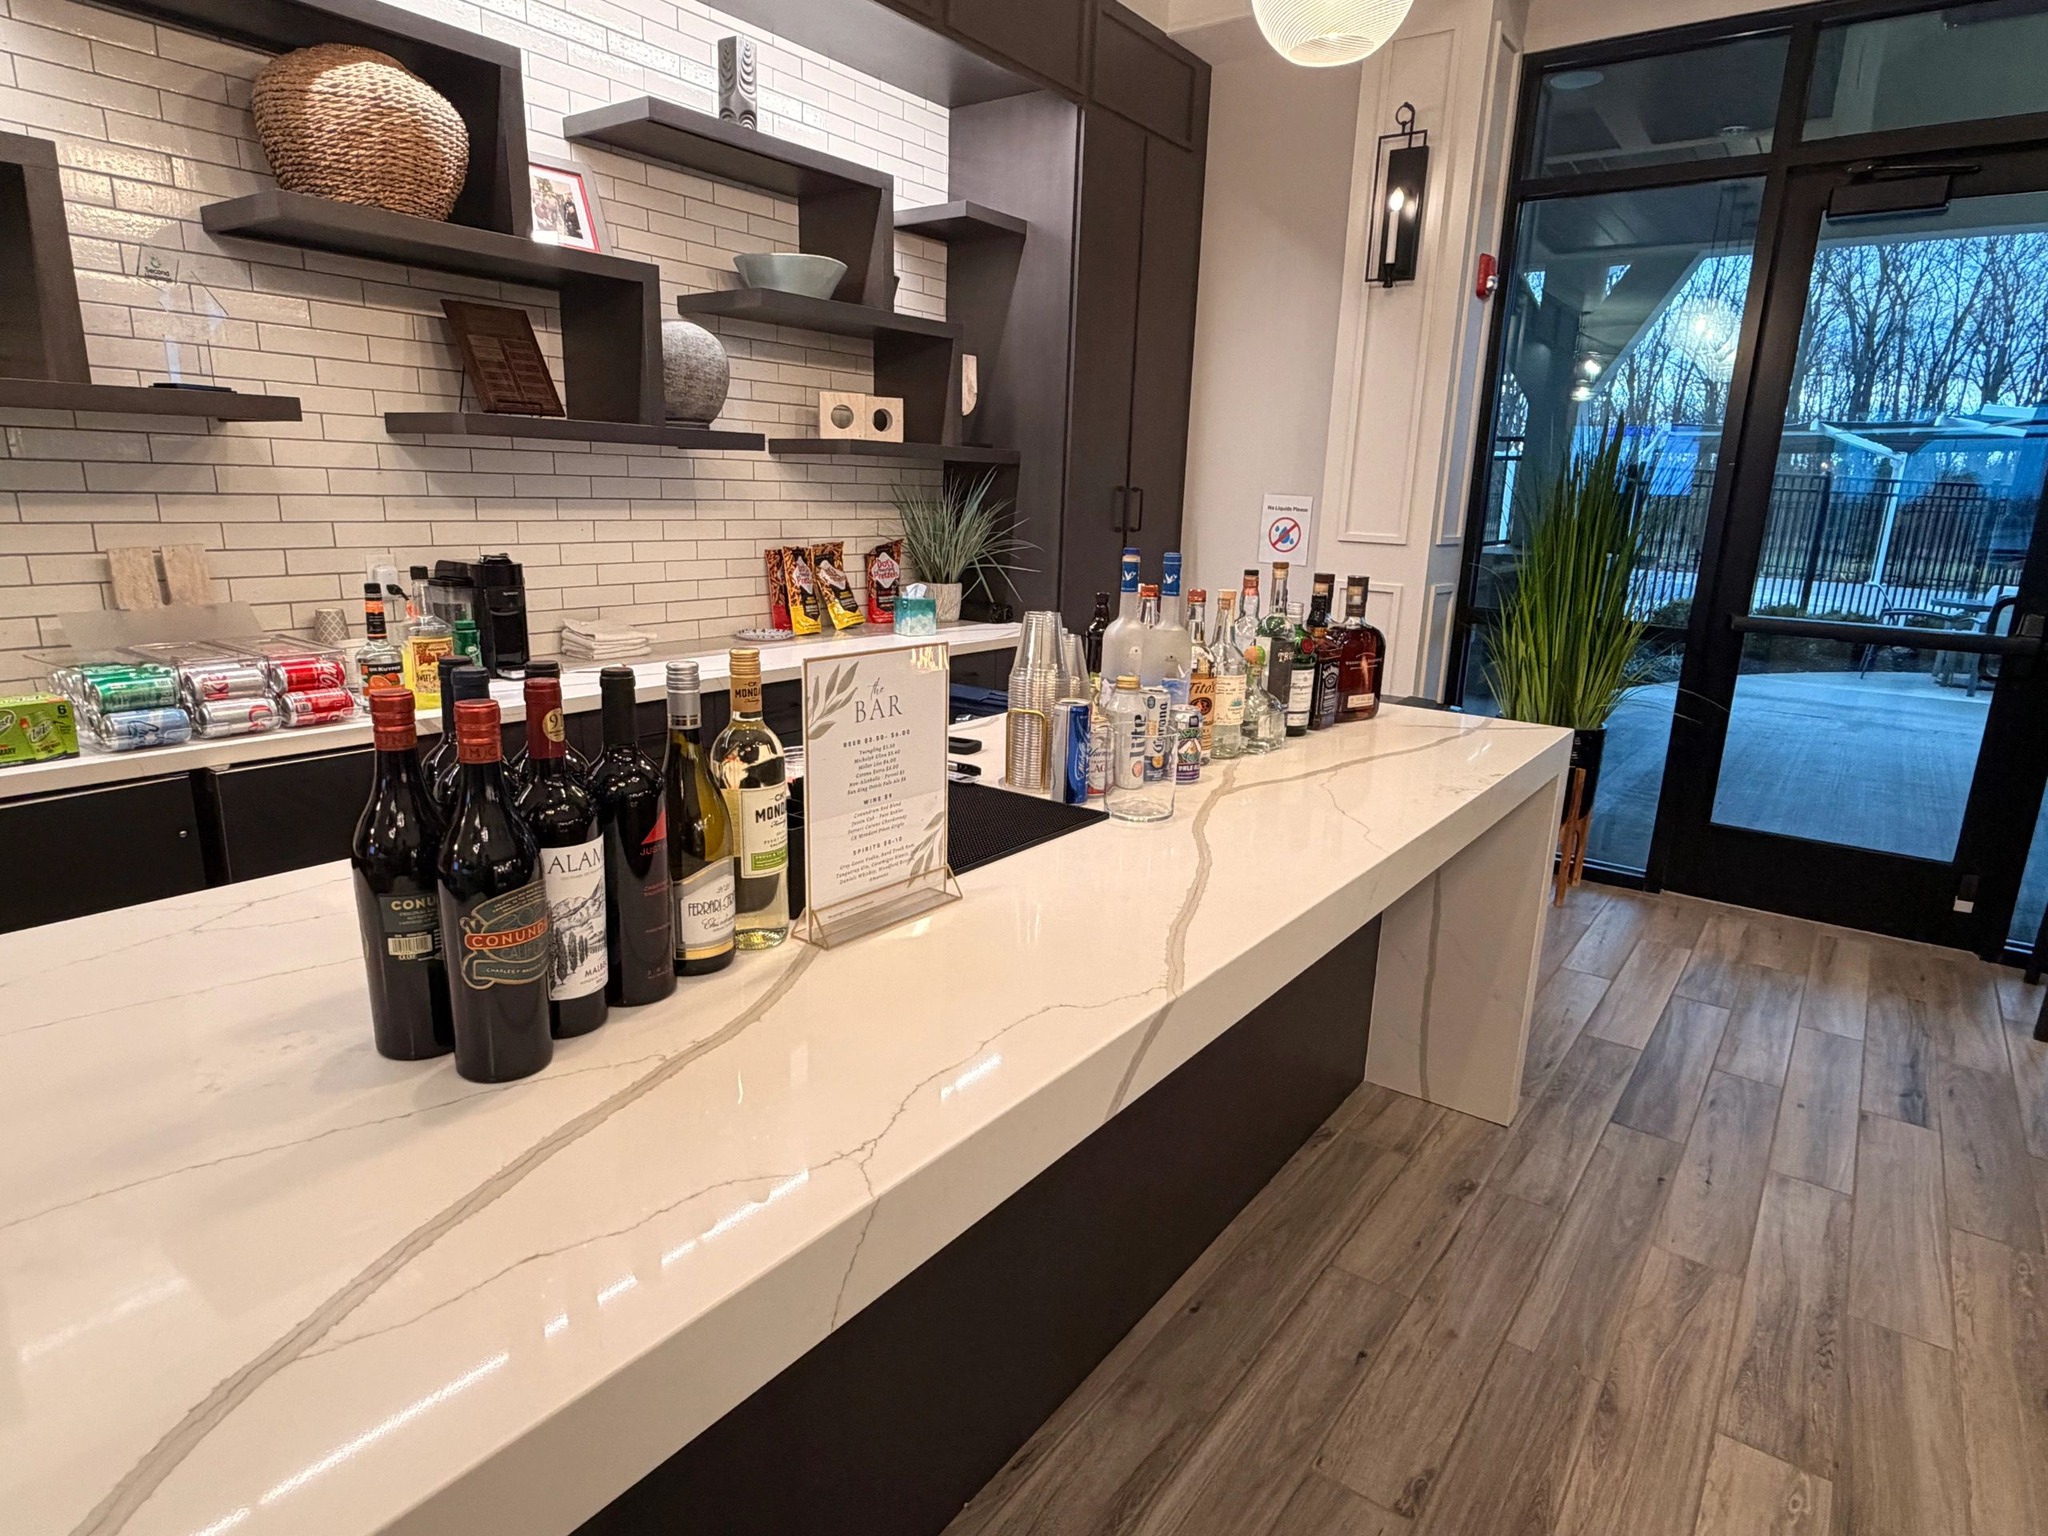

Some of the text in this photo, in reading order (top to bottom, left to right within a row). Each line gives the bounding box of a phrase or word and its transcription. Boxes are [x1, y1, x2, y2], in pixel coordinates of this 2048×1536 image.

[145, 266, 170, 277] Second
[867, 677, 883, 700] the
[1190, 681, 1216, 694] Tito's
[57, 704, 67, 714] 6
[854, 693, 902, 722] BAR
[1153, 702, 1168, 754] Corona
[863, 796, 880, 804] WINE
[854, 808, 879, 818] Conundrum
[882, 814, 906, 825] Chardonnay
[853, 843, 879, 855] SPIRITS
[472, 922, 544, 947] CONUND
